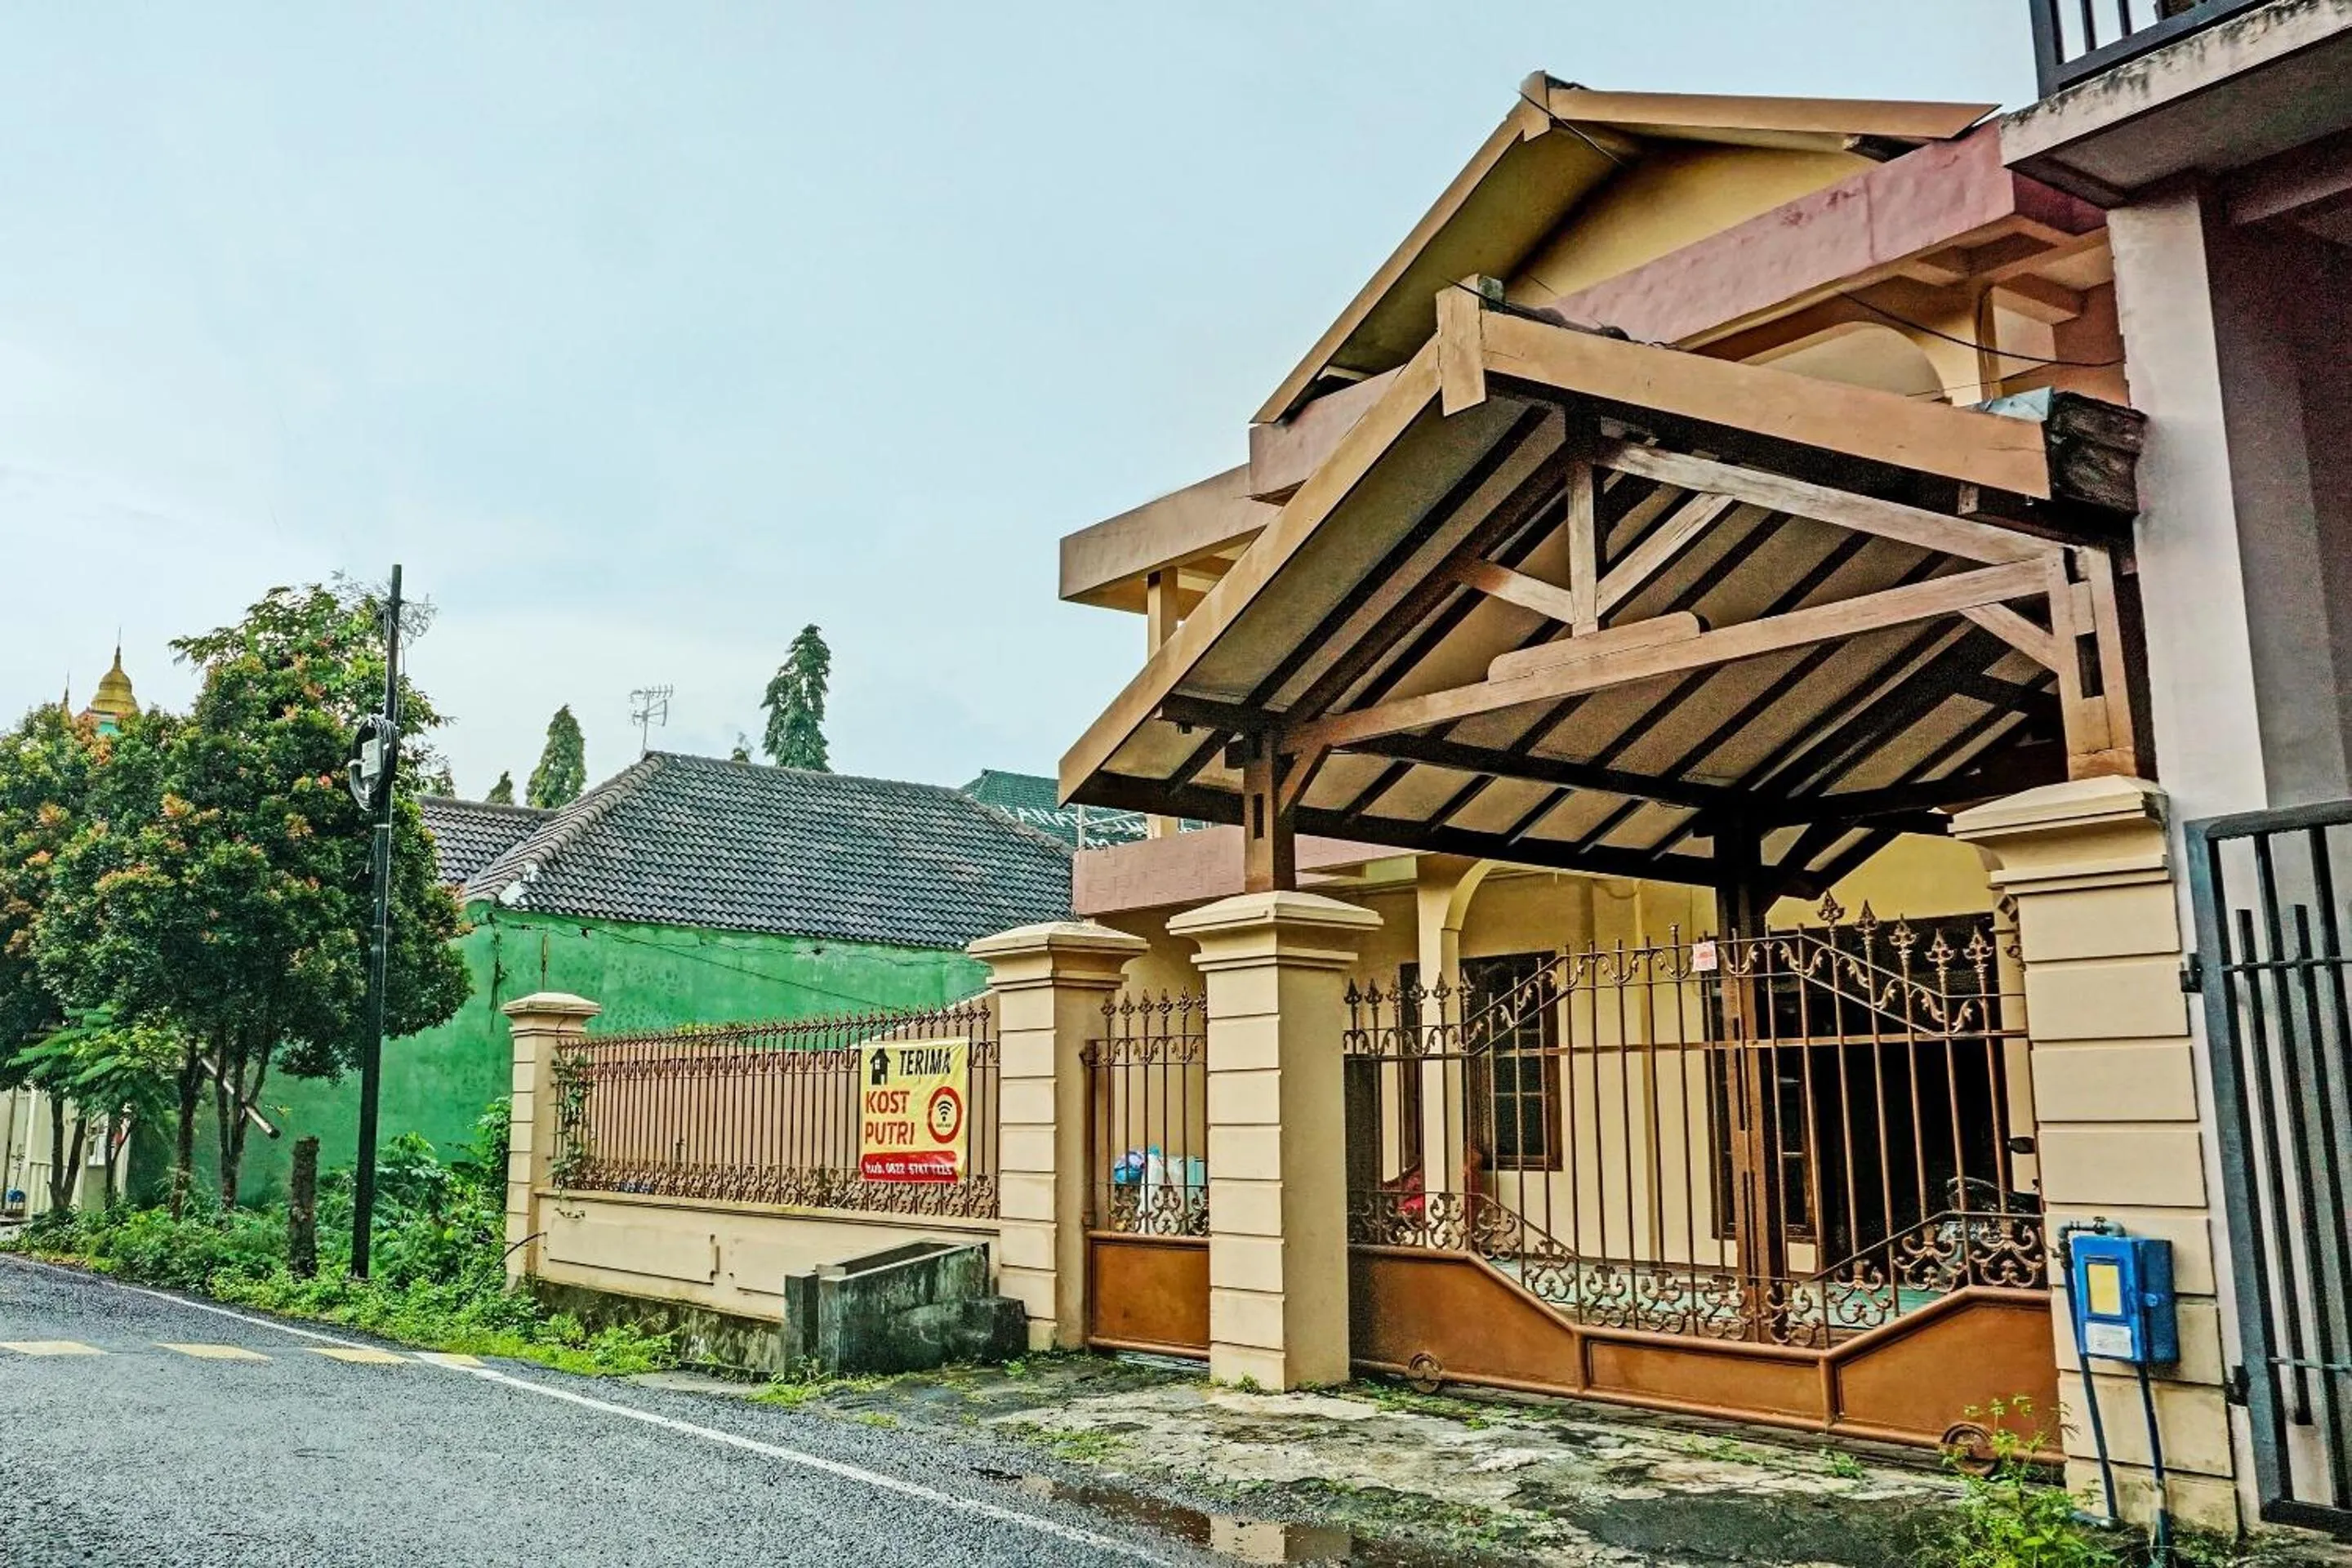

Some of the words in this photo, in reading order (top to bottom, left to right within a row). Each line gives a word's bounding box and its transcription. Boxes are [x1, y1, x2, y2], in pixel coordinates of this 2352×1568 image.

[899, 1048, 951, 1076] TERIMA
[865, 1091, 910, 1114] KOST
[865, 1121, 915, 1145] PUTRI
